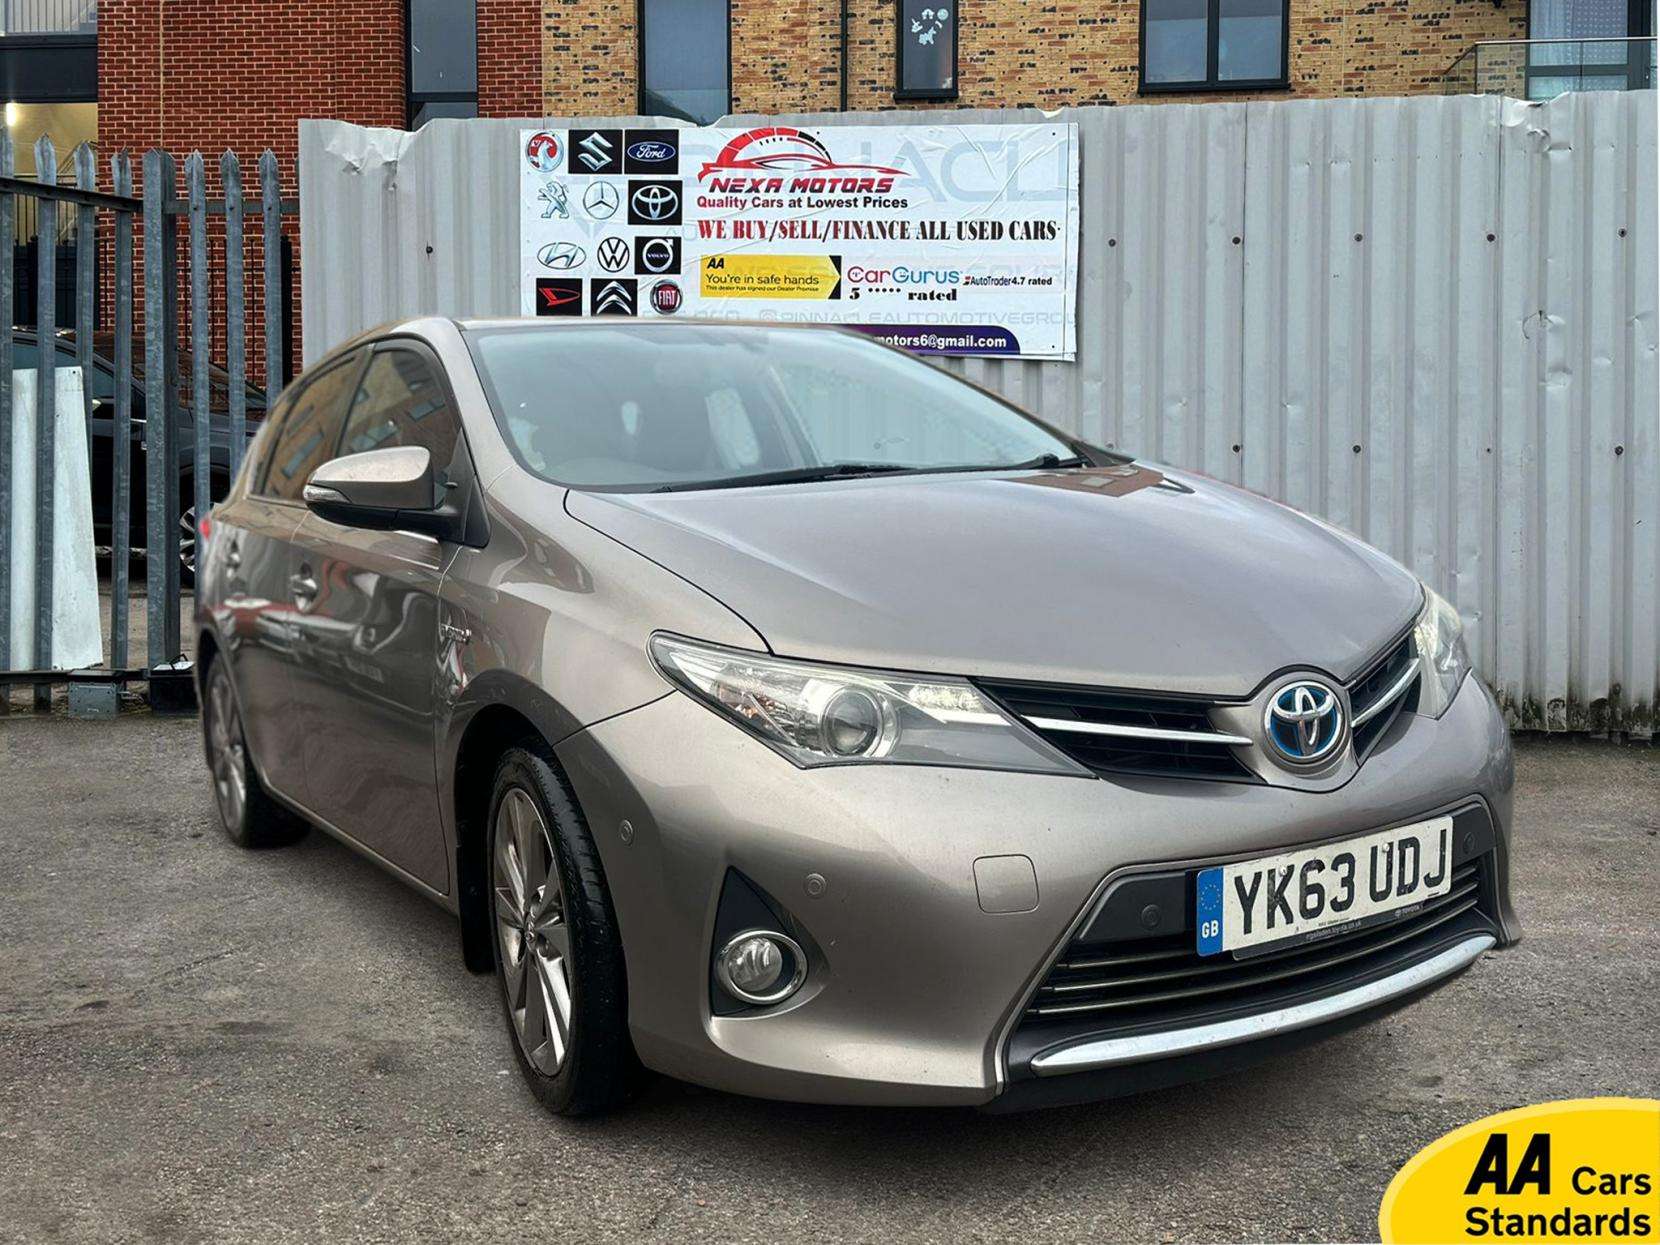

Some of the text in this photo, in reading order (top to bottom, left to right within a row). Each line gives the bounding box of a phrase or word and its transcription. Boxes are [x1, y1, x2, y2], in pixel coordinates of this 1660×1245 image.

[636, 144, 666, 158] Ford
[709, 177, 894, 194] NEXA MOTORS
[697, 195, 908, 211] Quality Cars at Lowest Prices
[697, 219, 727, 240] WE
[916, 220, 950, 240] ALL
[956, 220, 1004, 241] USED
[706, 257, 725, 270] AA
[705, 273, 819, 285] You're in safe hands
[847, 265, 960, 285] CarGurus
[1028, 276, 1053, 286] rated
[658, 290, 677, 306] FIAT
[849, 287, 958, 301] 5 rated
[1234, 828, 1448, 936] YK63 UDJ
[1201, 919, 1219, 939] GB
